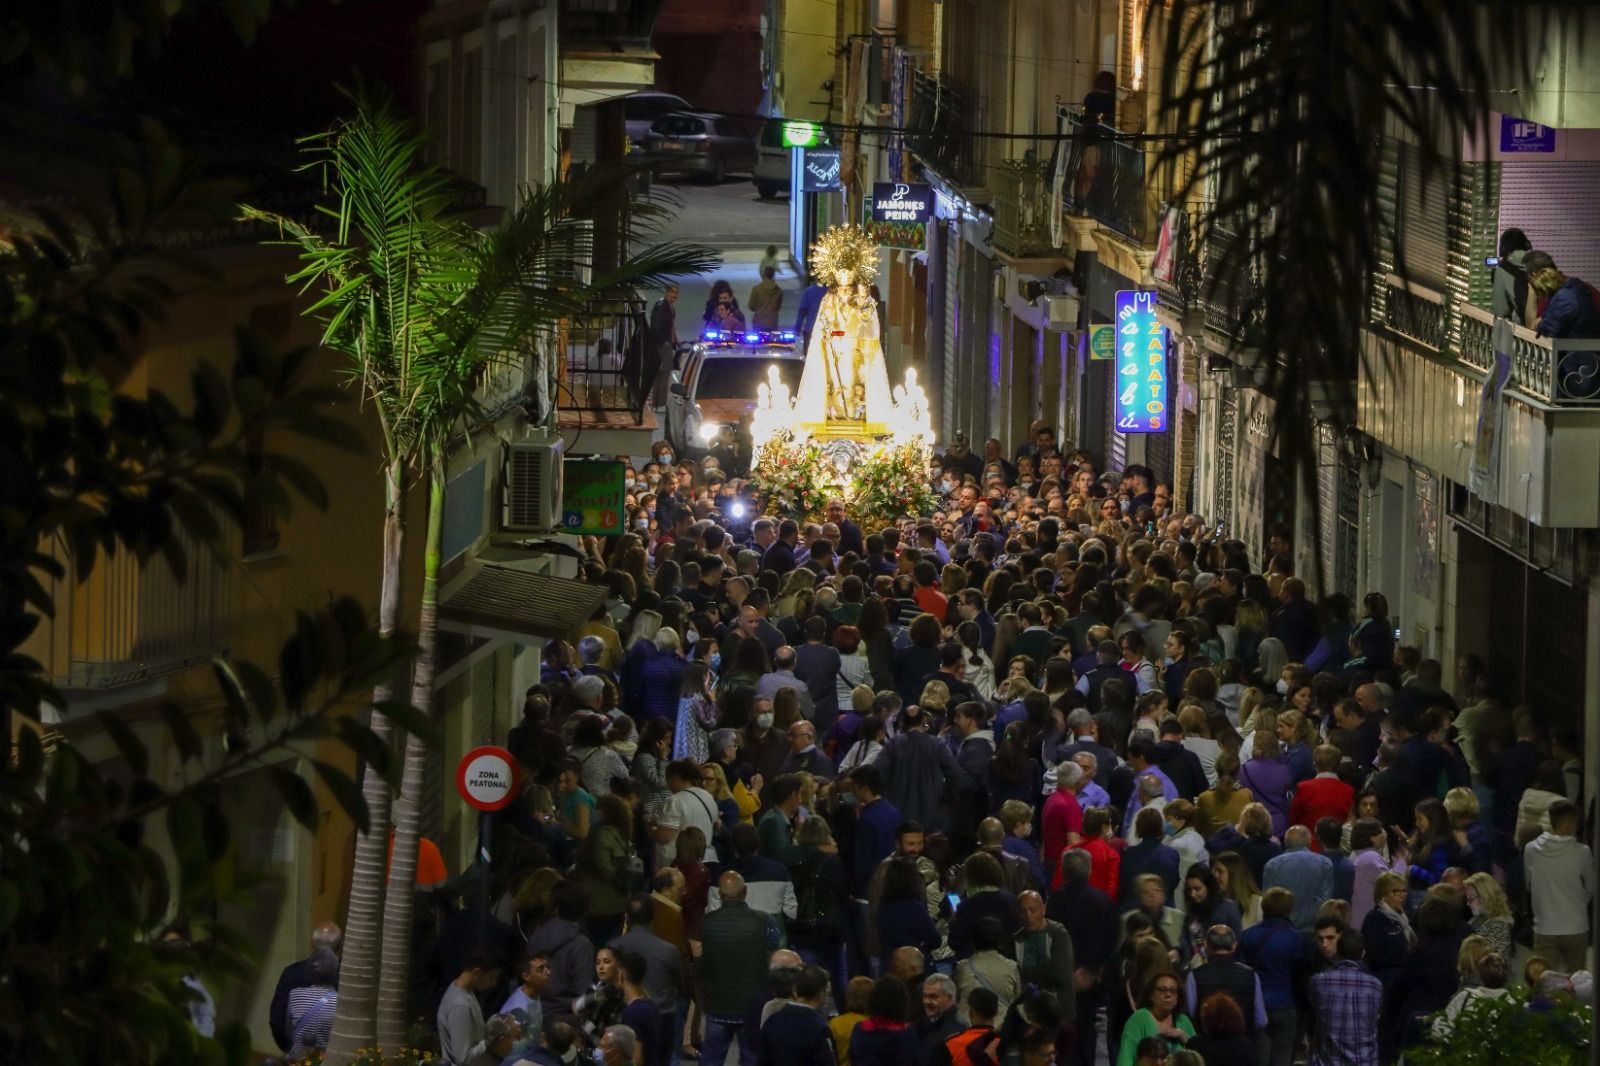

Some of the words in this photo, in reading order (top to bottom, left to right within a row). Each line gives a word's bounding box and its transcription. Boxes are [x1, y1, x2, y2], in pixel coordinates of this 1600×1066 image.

[876, 200, 926, 211] JAMONES
[884, 210, 917, 221] PEIRÓ
[1146, 321, 1164, 429] ZAPATOS
[477, 771, 499, 779] ZONA
[469, 780, 508, 789] PEATONAL
